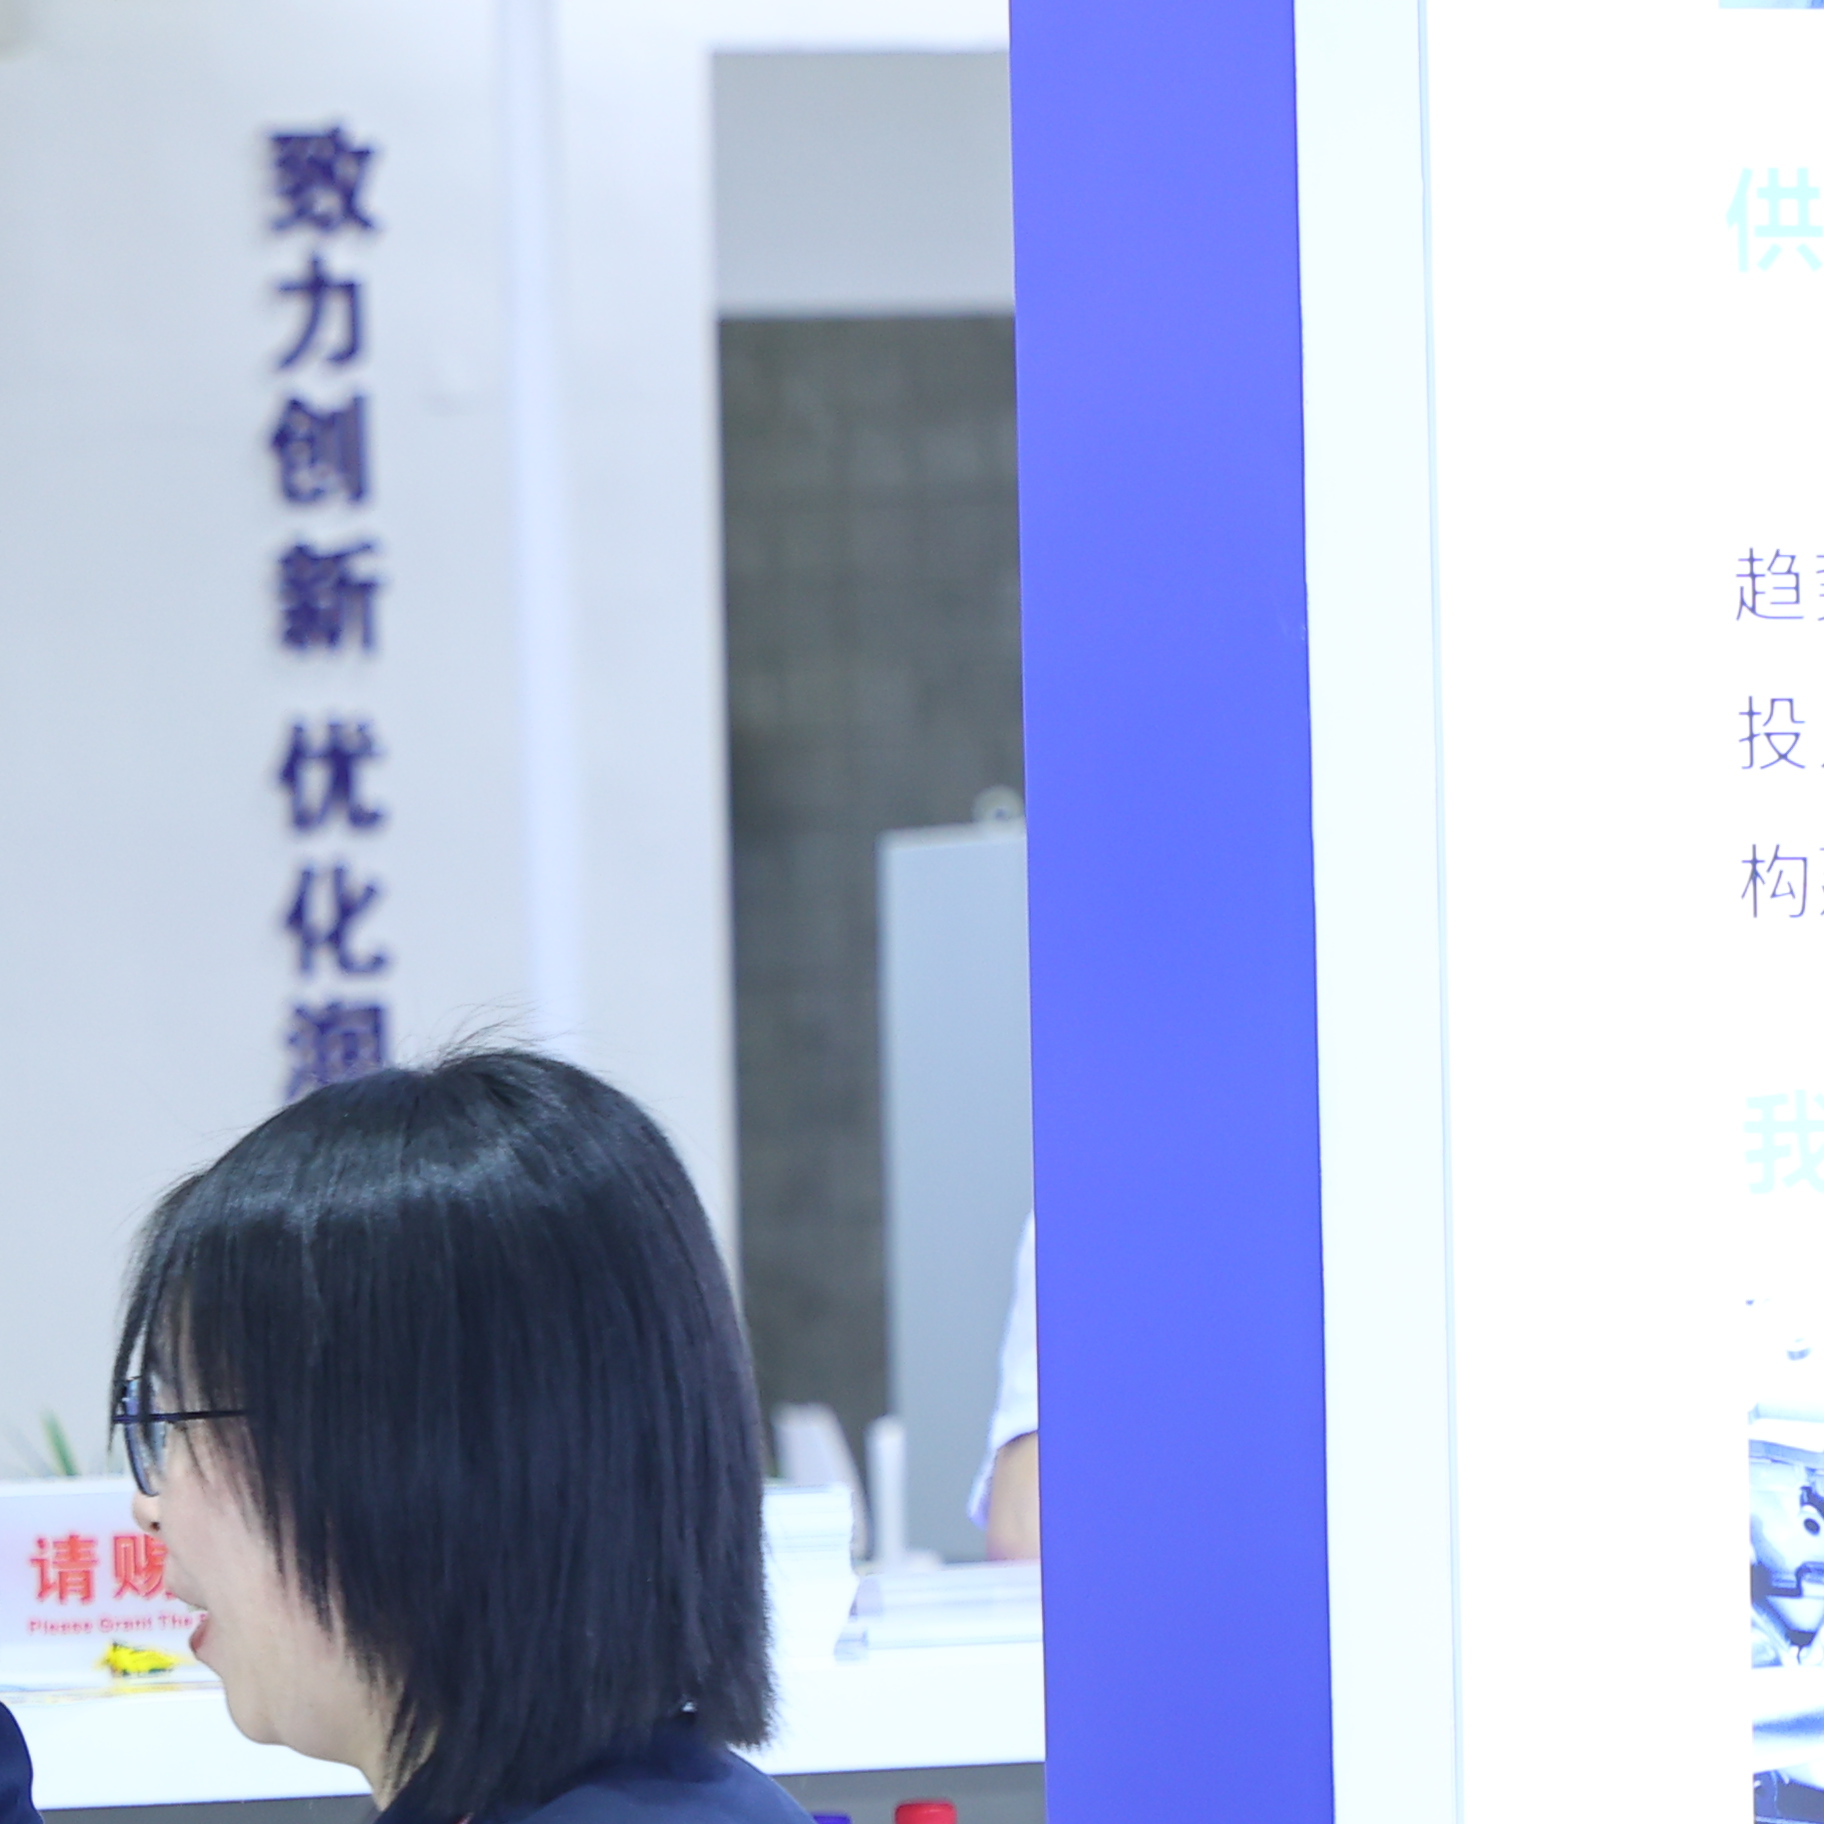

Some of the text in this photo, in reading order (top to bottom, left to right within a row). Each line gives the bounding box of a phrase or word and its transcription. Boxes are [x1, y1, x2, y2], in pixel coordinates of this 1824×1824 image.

[1725, 166, 1824, 273] 供
[266, 126, 385, 656] 致力创新
[1736, 547, 1824, 621] 趋
[1738, 696, 1824, 770] 投
[1740, 843, 1824, 918] 构
[28, 1619, 93, 1635] Please
[100, 1616, 152, 1633] Grant
[158, 1613, 194, 1630] The
